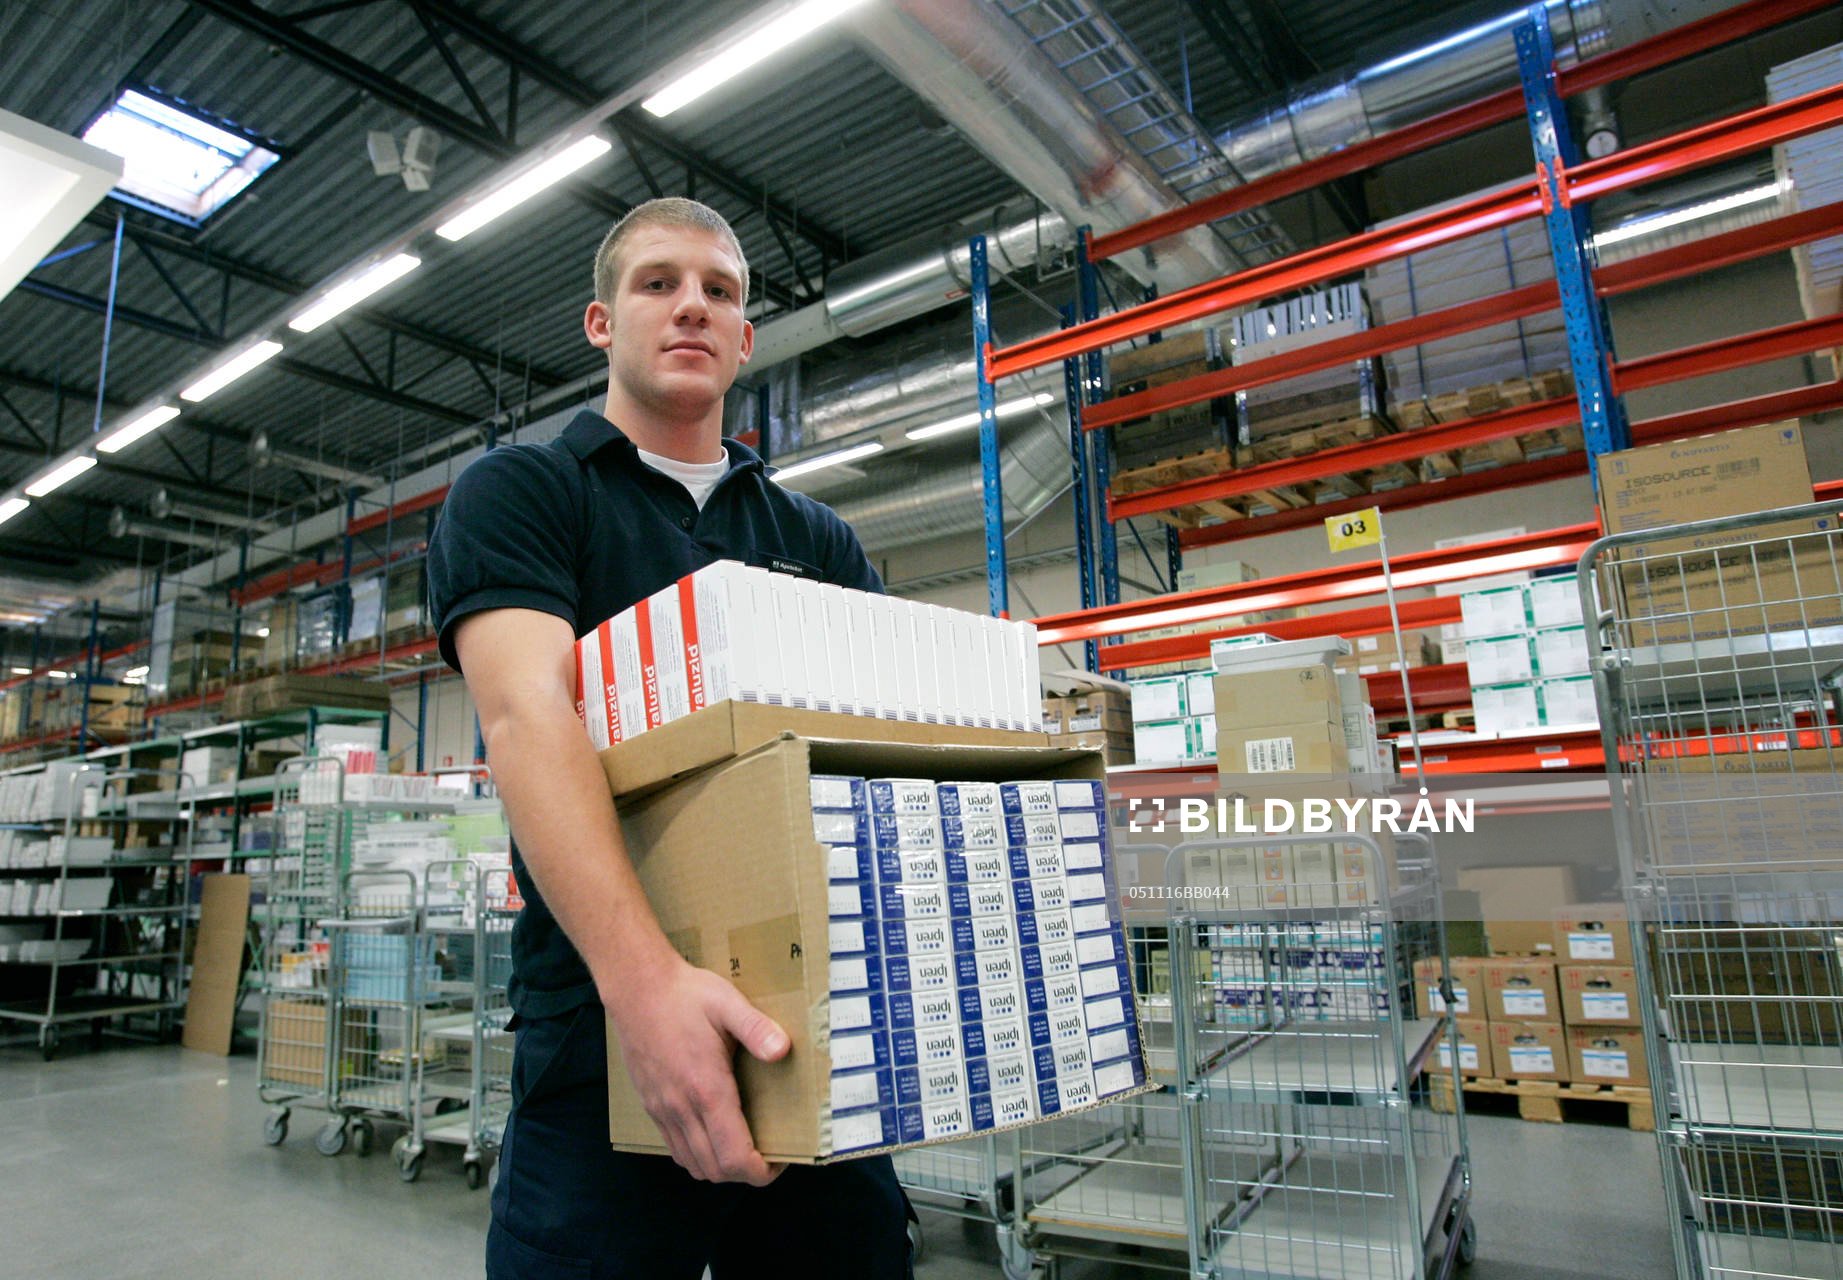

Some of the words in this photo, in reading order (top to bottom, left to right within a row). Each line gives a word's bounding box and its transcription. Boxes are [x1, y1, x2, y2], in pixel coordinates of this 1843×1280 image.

[1625, 465, 1712, 489] ISOSOURCE
[1342, 520, 1366, 537] 03
[909, 859, 938, 874] Ipren
[975, 859, 1001, 873] Ipren
[1036, 853, 1059, 869] Ipren
[978, 892, 1004, 906] Ipren
[1040, 885, 1064, 900] Ipren
[913, 894, 941, 910] Ipren
[982, 926, 1008, 940] Ipren
[1044, 920, 1068, 934] Ipren
[916, 929, 944, 944] Ipren
[1049, 950, 1073, 965] Ipren
[920, 963, 948, 979] Ipren
[985, 959, 1012, 974] Ipren
[1053, 984, 1077, 999] Ipren
[923, 999, 951, 1016] Ipren
[989, 993, 1016, 1009] Ipren
[1057, 1015, 1081, 1032] Ipren
[993, 1028, 1020, 1043] Ipren
[926, 1037, 955, 1053] Ipren
[1062, 1049, 1087, 1065] Ipren
[998, 1062, 1024, 1078] Ipren
[929, 1073, 959, 1089] Ipren
[1066, 1082, 1091, 1098] Ipren
[1002, 1099, 1028, 1115] Ipren
[933, 1110, 962, 1127] Ipren
